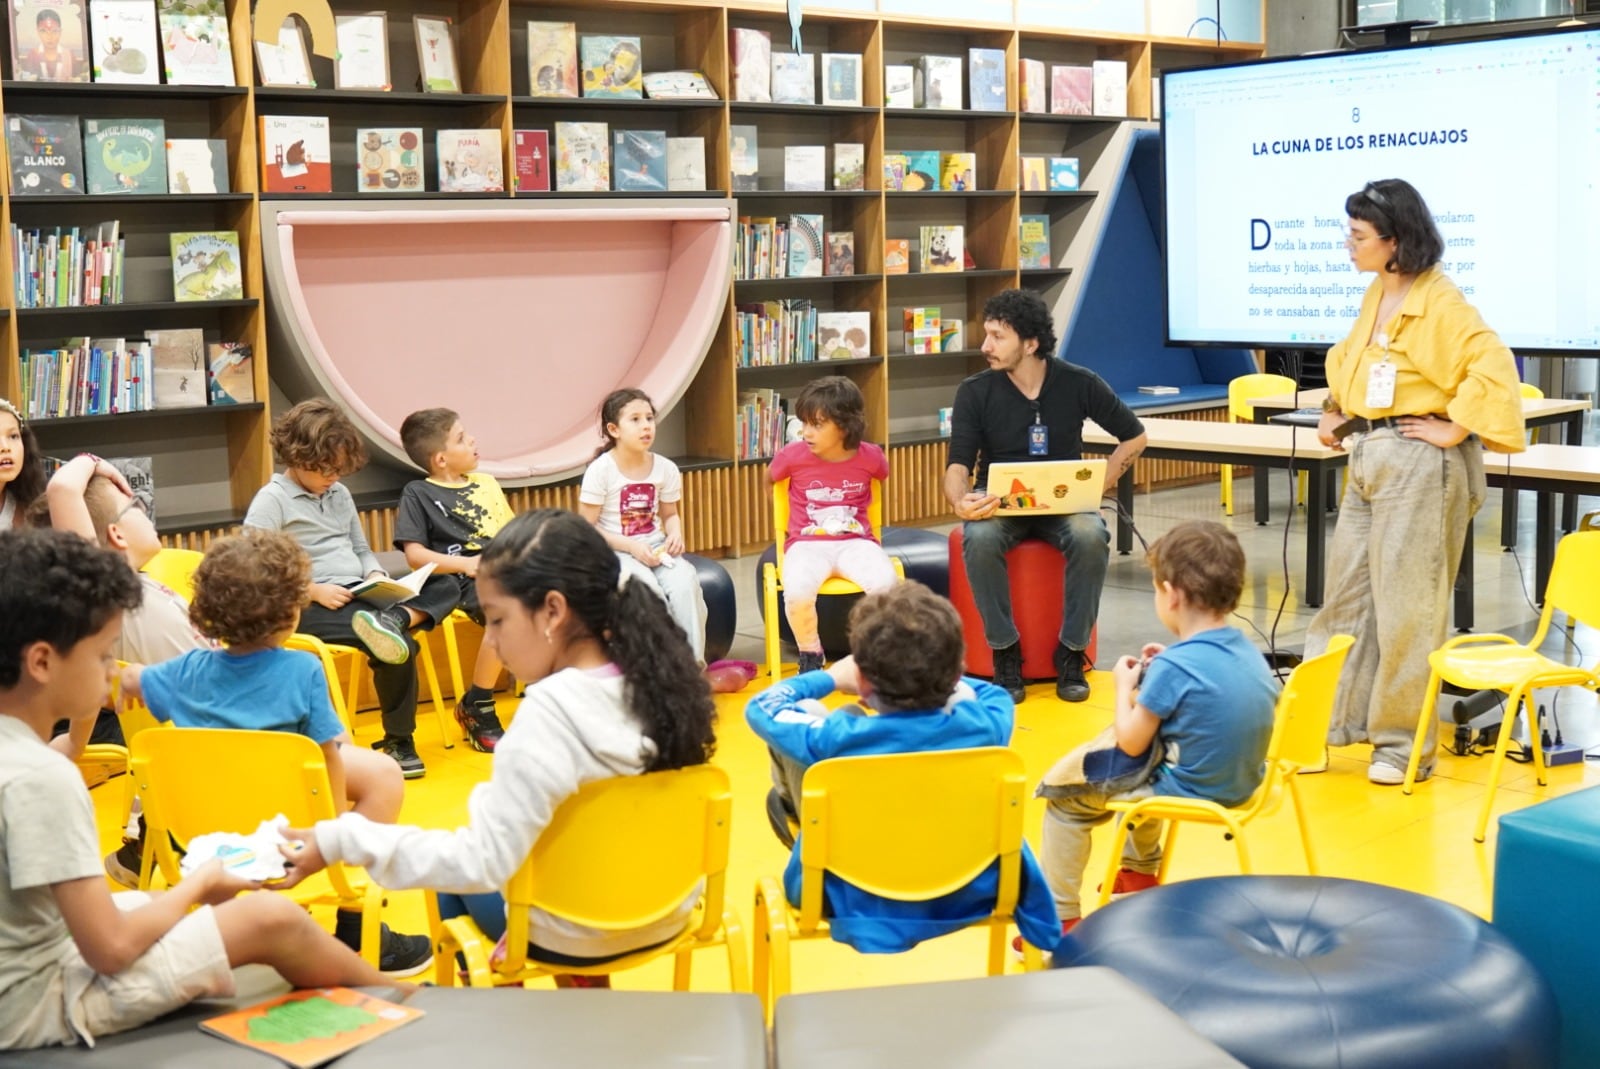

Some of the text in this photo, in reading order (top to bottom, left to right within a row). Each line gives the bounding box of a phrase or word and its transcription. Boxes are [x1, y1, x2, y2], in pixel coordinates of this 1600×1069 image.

[1352, 107, 1361, 123] 8
[1253, 129, 1468, 156] LA CUNA DE LOS RENACUAJOS
[24, 156, 66, 167] BLANCO
[1274, 240, 1295, 251] toda
[1298, 240, 1307, 250] la
[1310, 242, 1333, 251] zona
[1447, 236, 1476, 248] entre
[1248, 261, 1281, 273] hierbas
[1285, 264, 1290, 275] y
[1294, 261, 1322, 275] hojas,
[1326, 261, 1352, 273] hasta
[1457, 262, 1476, 274] por
[1248, 284, 1308, 296] desaparecida
[1309, 283, 1344, 297] aquella
[1248, 306, 1260, 316] no
[1263, 307, 1273, 316] se
[1276, 305, 1320, 317] cansaban
[1324, 305, 1336, 317] de
